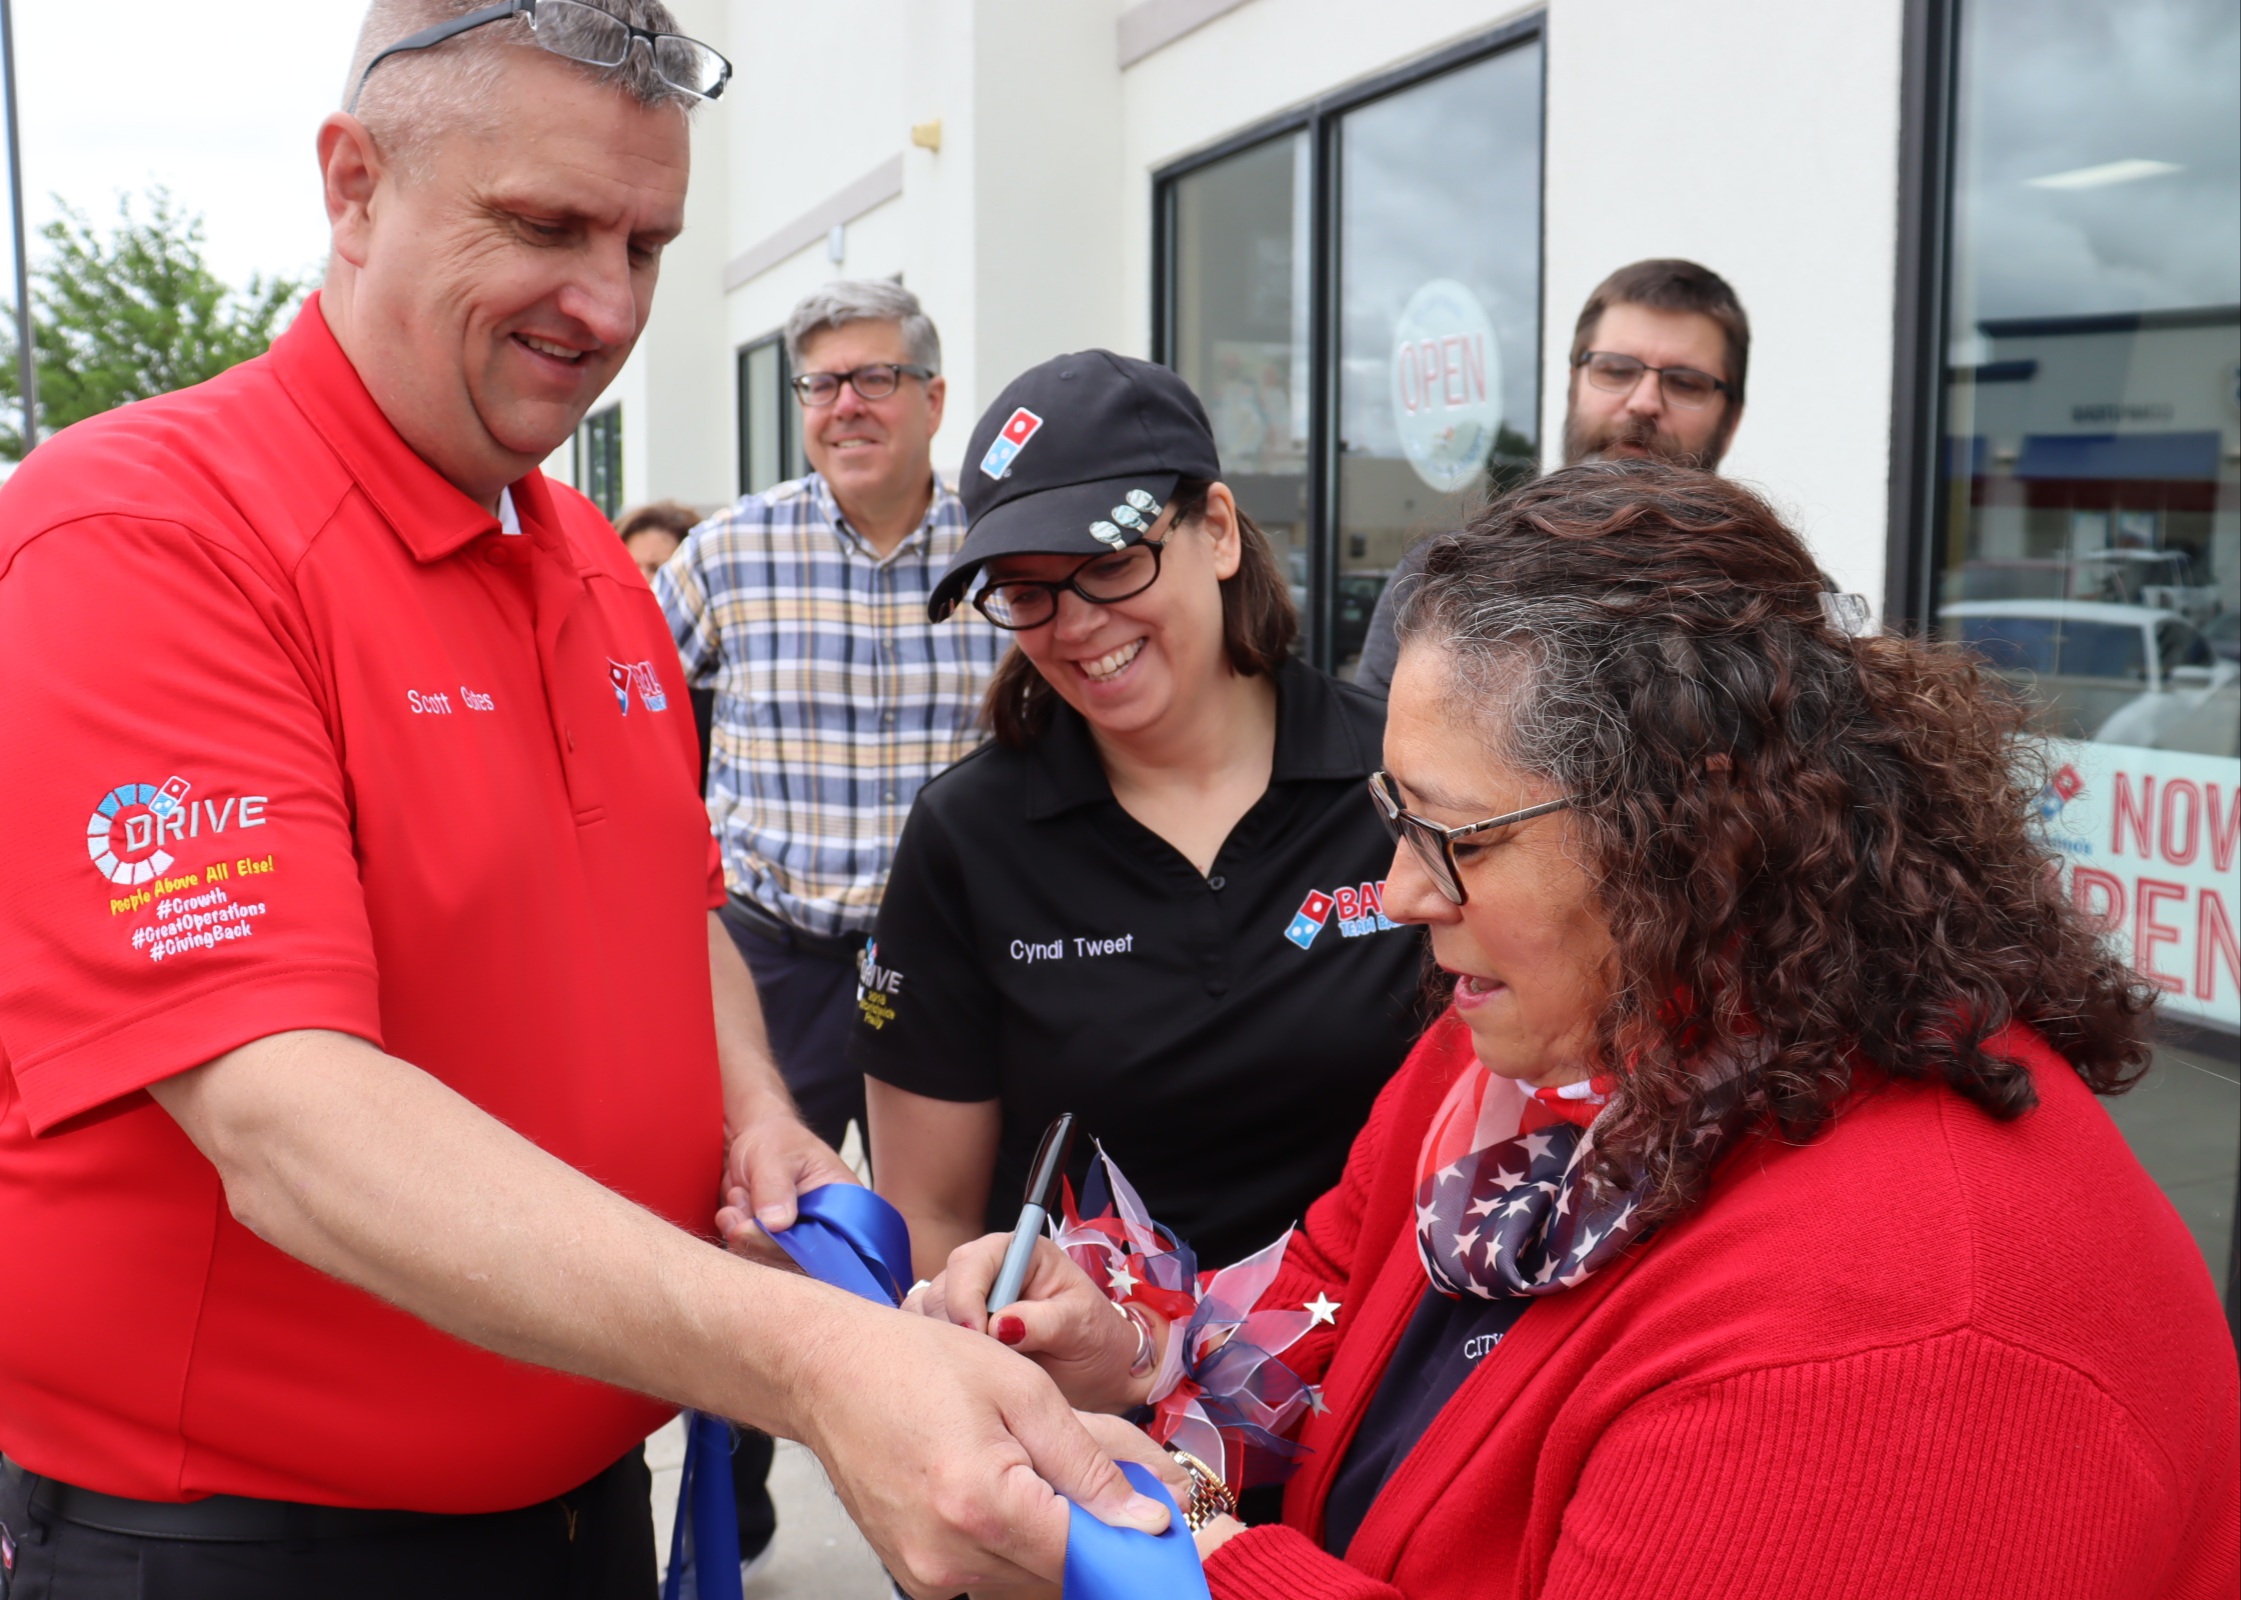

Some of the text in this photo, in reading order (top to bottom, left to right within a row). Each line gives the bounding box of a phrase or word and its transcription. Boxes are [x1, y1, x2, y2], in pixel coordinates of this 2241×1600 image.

[1398, 332, 1487, 415] OPEN
[407, 689, 452, 715] Scott
[124, 796, 269, 853] DRIVE
[109, 854, 274, 916] People Above All Else!
[1338, 915, 1377, 937] TEAM
[1010, 933, 1133, 964] Cyndi Tweet
